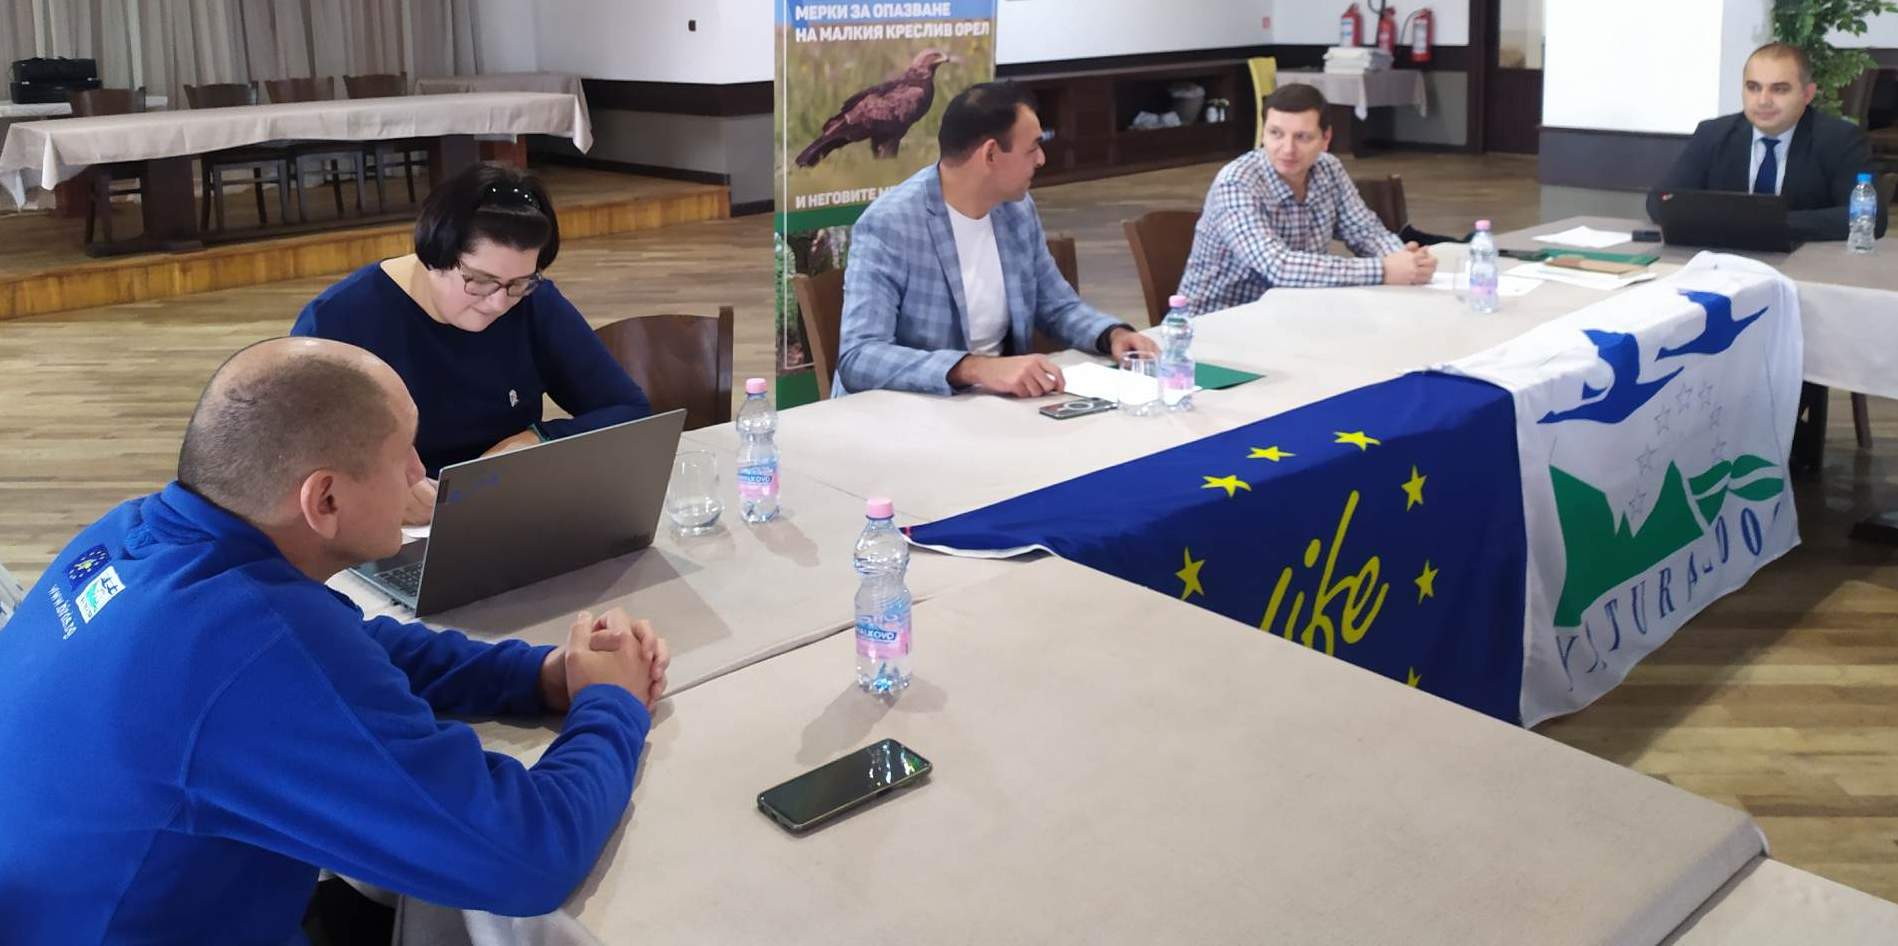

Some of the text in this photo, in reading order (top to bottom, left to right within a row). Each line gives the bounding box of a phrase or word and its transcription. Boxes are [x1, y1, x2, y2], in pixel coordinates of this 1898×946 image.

[796, 2, 951, 20] МЕРКИ ЗА ОПАЗВАНЕ
[796, 21, 990, 42] НА МАЛКИЯ КРЕСЛИВ ОРЕЛ
[795, 196, 806, 209] И
[807, 188, 876, 208] НЕГОВИТЕ
